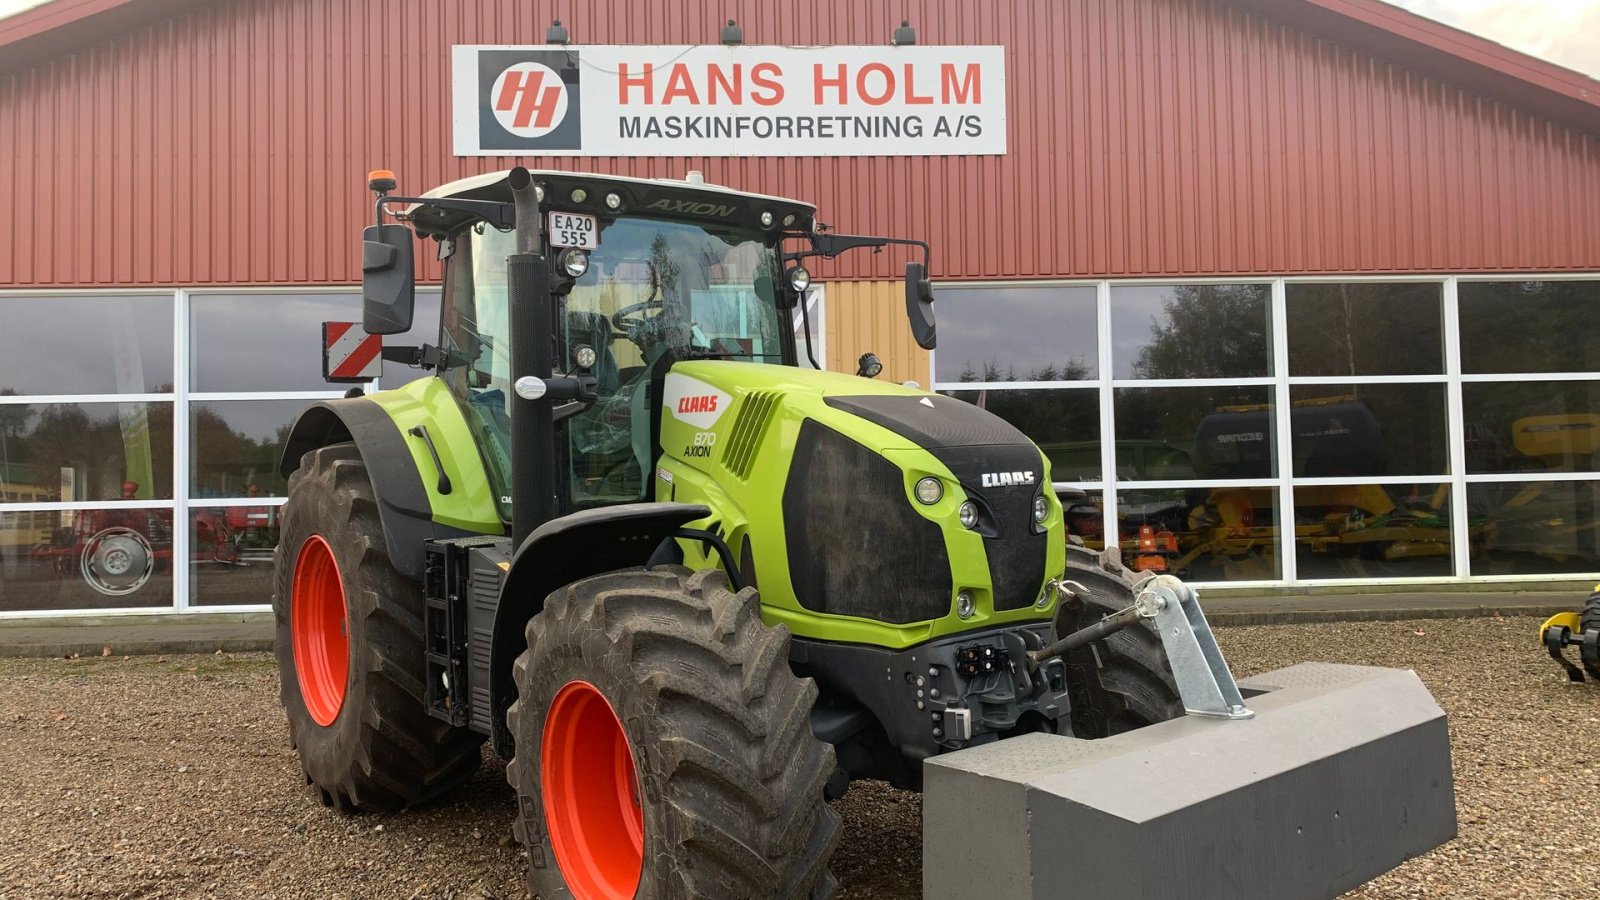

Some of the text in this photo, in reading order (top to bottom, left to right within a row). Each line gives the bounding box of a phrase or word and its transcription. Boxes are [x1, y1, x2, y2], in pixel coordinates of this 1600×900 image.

[618, 62, 982, 106] HANS HOLM
[619, 115, 982, 138] MASKINFORRETNING A/S
[647, 198, 737, 217] AXION
[554, 214, 593, 232] EA20
[561, 230, 587, 246] 555
[677, 395, 718, 413] CLAAS
[694, 432, 716, 446] 870
[684, 446, 711, 458] AXION
[981, 470, 1035, 488] CLAAS
